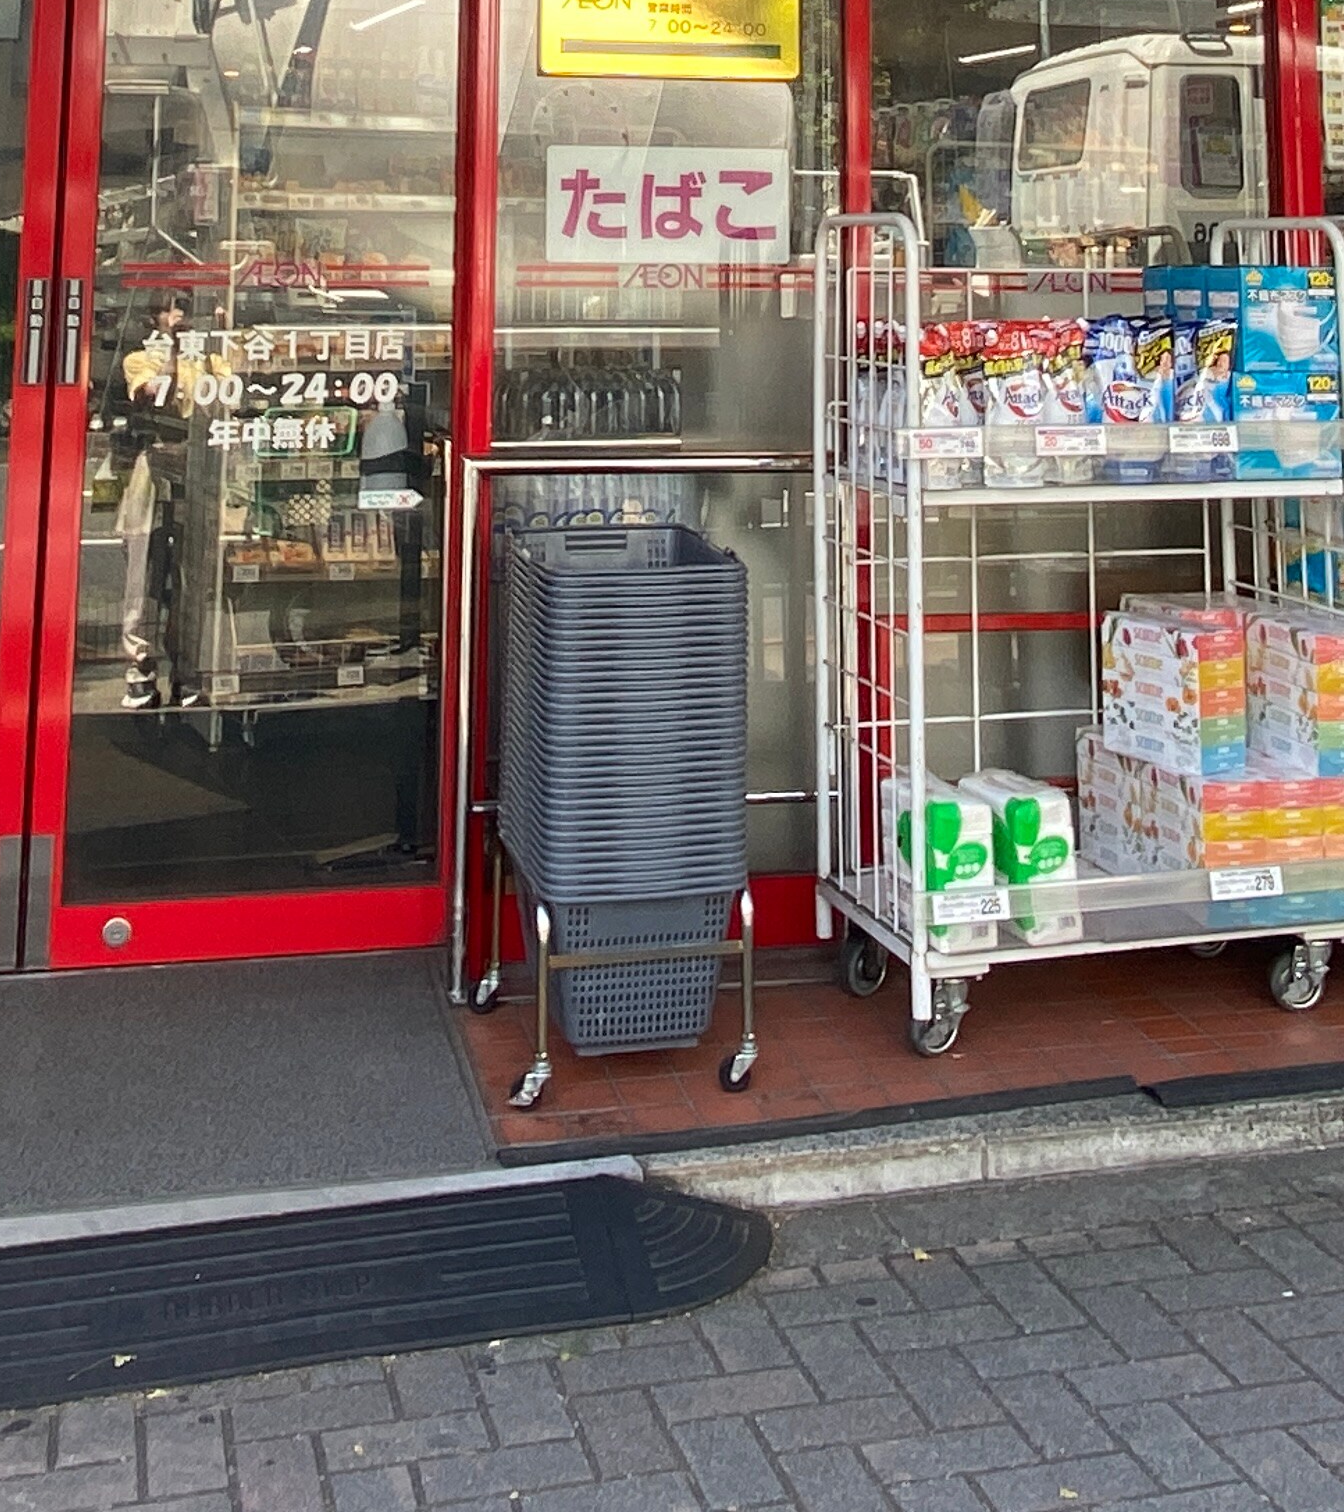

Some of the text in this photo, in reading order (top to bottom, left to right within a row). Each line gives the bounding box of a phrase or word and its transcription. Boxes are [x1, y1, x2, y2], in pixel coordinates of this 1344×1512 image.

[561, 169, 777, 241] たばこ
[142, 330, 406, 363] 台東下谷1丁目店
[1104, 390, 1153, 411] Attack
[207, 416, 336, 451] 年中無休
[980, 898, 1002, 916] 225
